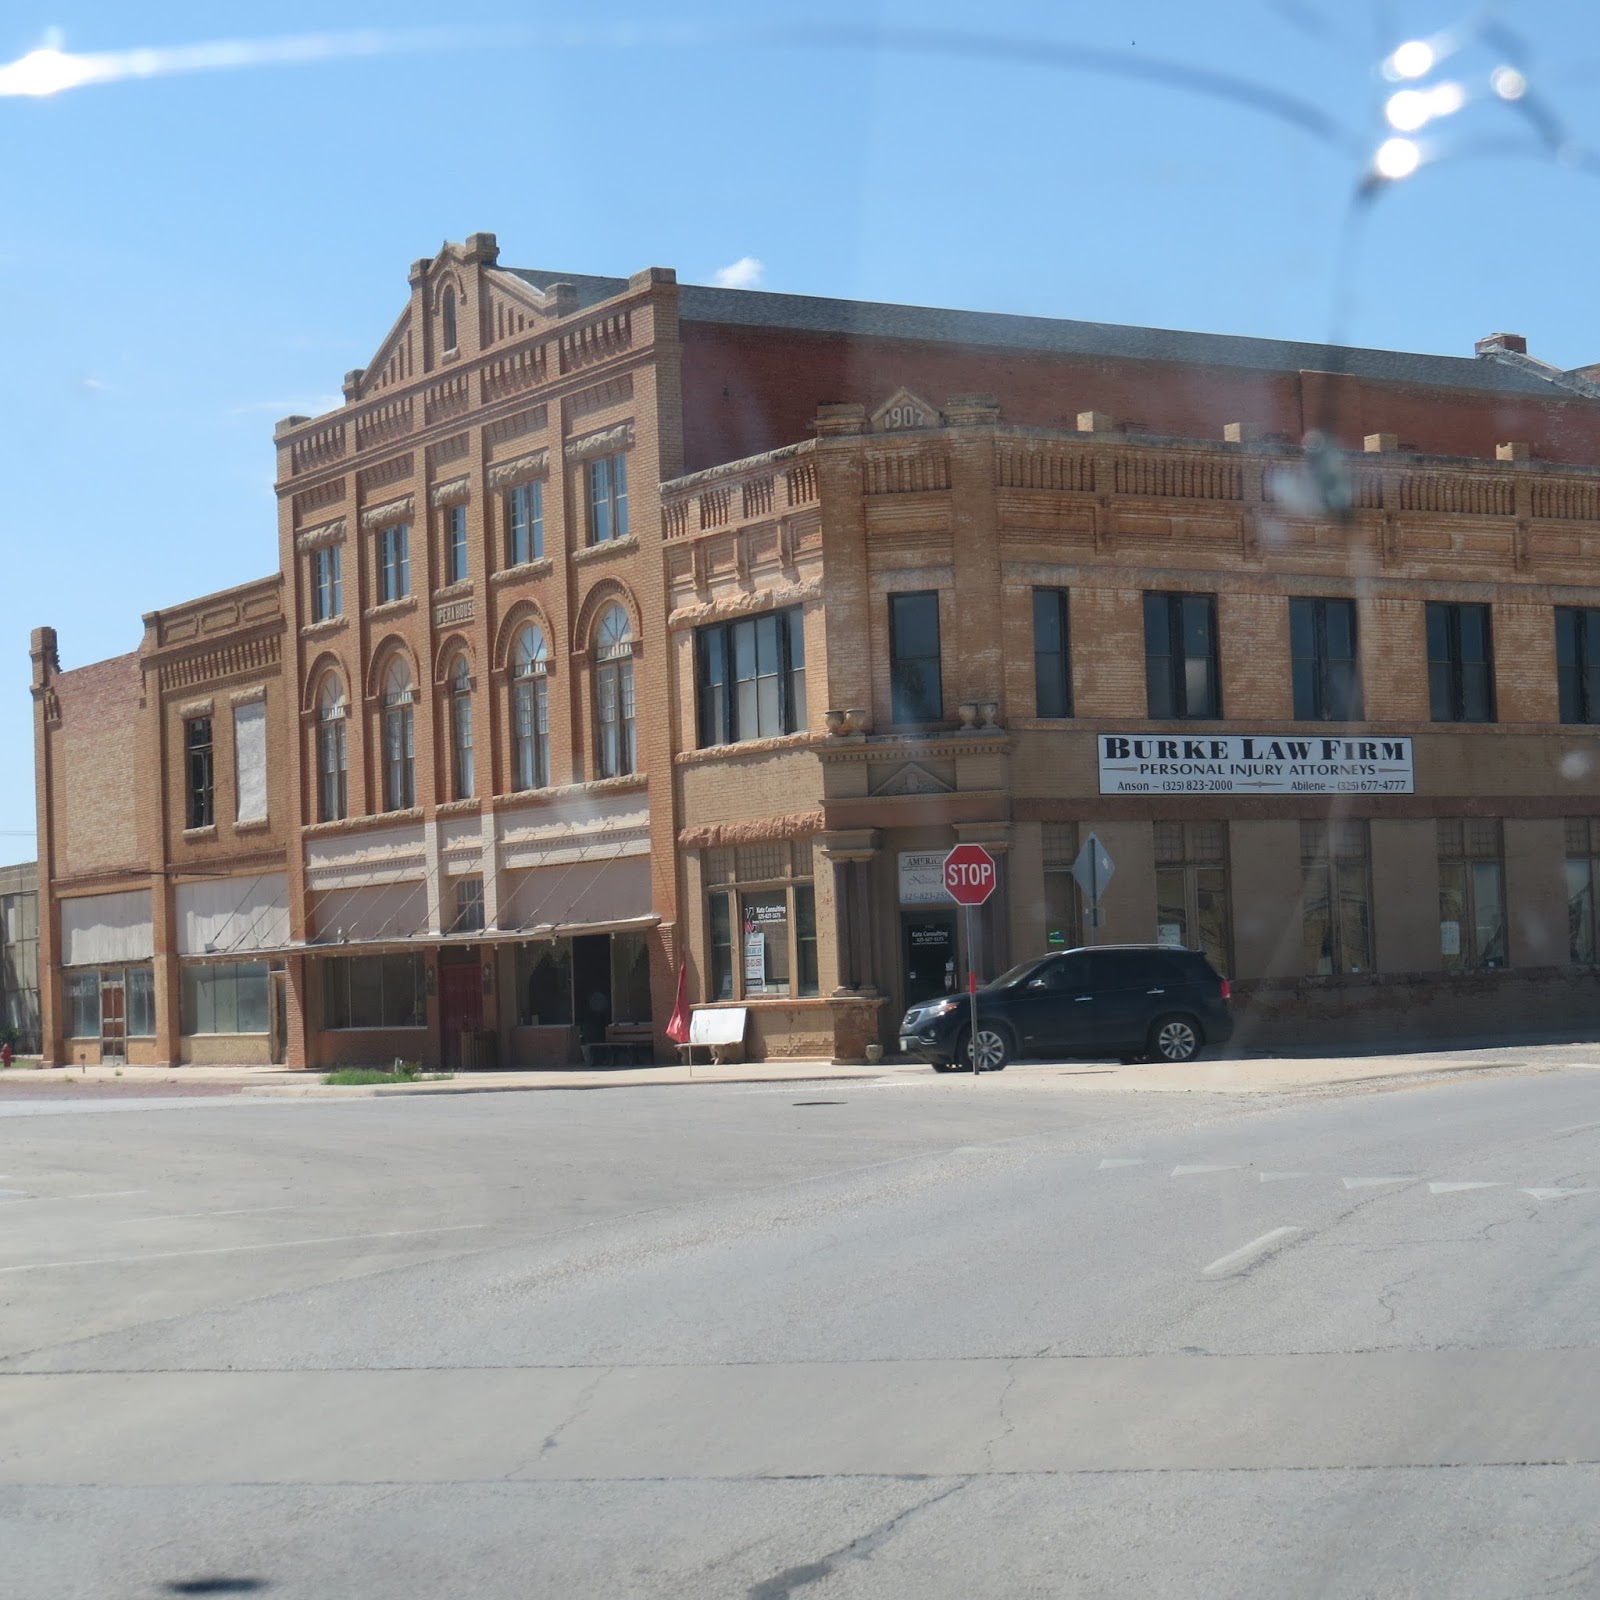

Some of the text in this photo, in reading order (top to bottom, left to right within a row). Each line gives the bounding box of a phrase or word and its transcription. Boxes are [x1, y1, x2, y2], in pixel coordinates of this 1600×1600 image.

[1104, 737, 1405, 761] BURKE LAW FIRM
[1140, 764, 1376, 777] PERSONAL INJURY ATTORNEYS
[1117, 781, 1150, 791] Anson
[1162, 780, 1185, 792] (325)
[1186, 780, 1233, 791] 823-2000
[1291, 780, 1326, 791] Abilene
[1337, 780, 1359, 792] (325)
[1360, 780, 1406, 791] 677-4777
[948, 863, 992, 887] STOP
[765, 905, 786, 914] Consulting
[923, 930, 949, 938] Consulting
